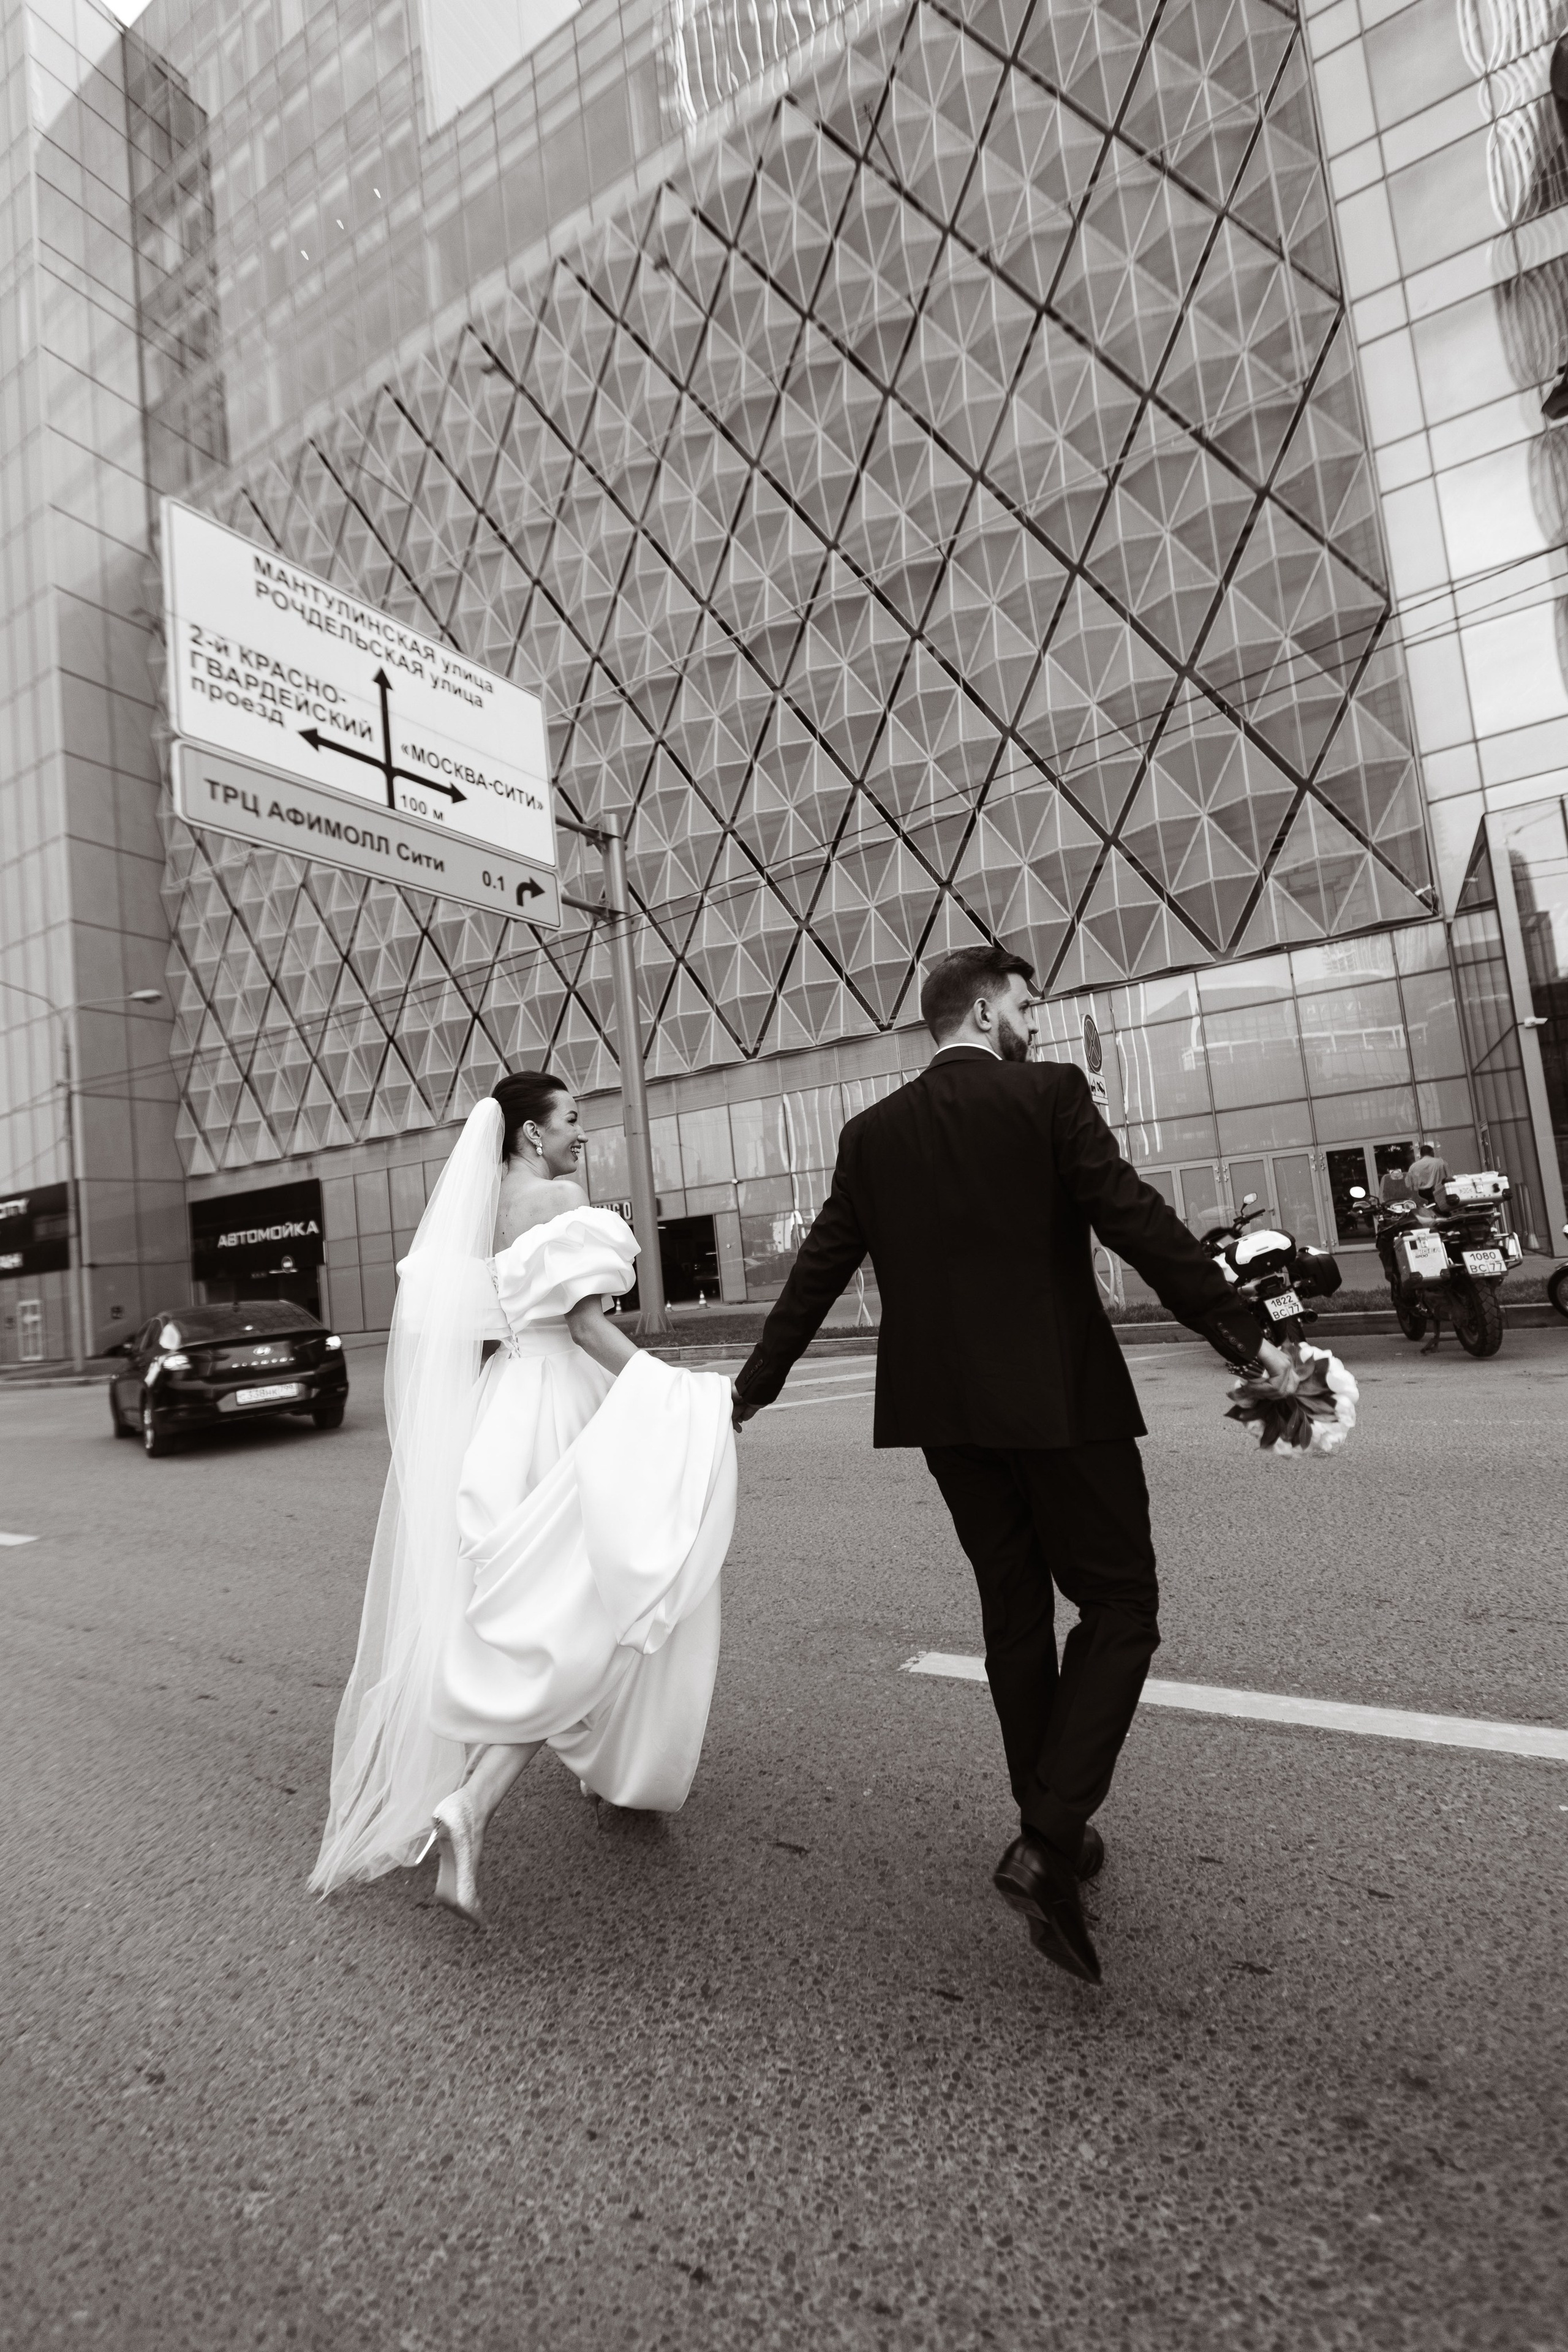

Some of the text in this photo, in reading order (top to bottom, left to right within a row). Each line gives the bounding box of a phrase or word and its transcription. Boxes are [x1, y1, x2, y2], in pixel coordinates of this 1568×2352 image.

[254, 556, 494, 693] МАНТУЛИНСКАЯ улица
[255, 580, 483, 708] РОЧДЕЛЬСКАЯ улица
[189, 624, 347, 704] 2-й КРАСНО-
[190, 650, 373, 742] ГВАРДЕЙСКИЙ
[191, 676, 284, 728] проезд
[401, 744, 544, 810] «МОСКВА-СИТИ»
[401, 795, 443, 821] 100 м
[204, 778, 505, 891] ТРЦ АФИМОЛЛ Сити 0.1
[217, 1220, 320, 1248] АВТОМОЙКА
[1470, 1251, 1496, 1261] 1080
[1489, 1262, 1502, 1272] 77
[1271, 1295, 1294, 1307] 1822
[1288, 1304, 1300, 1314] 77
